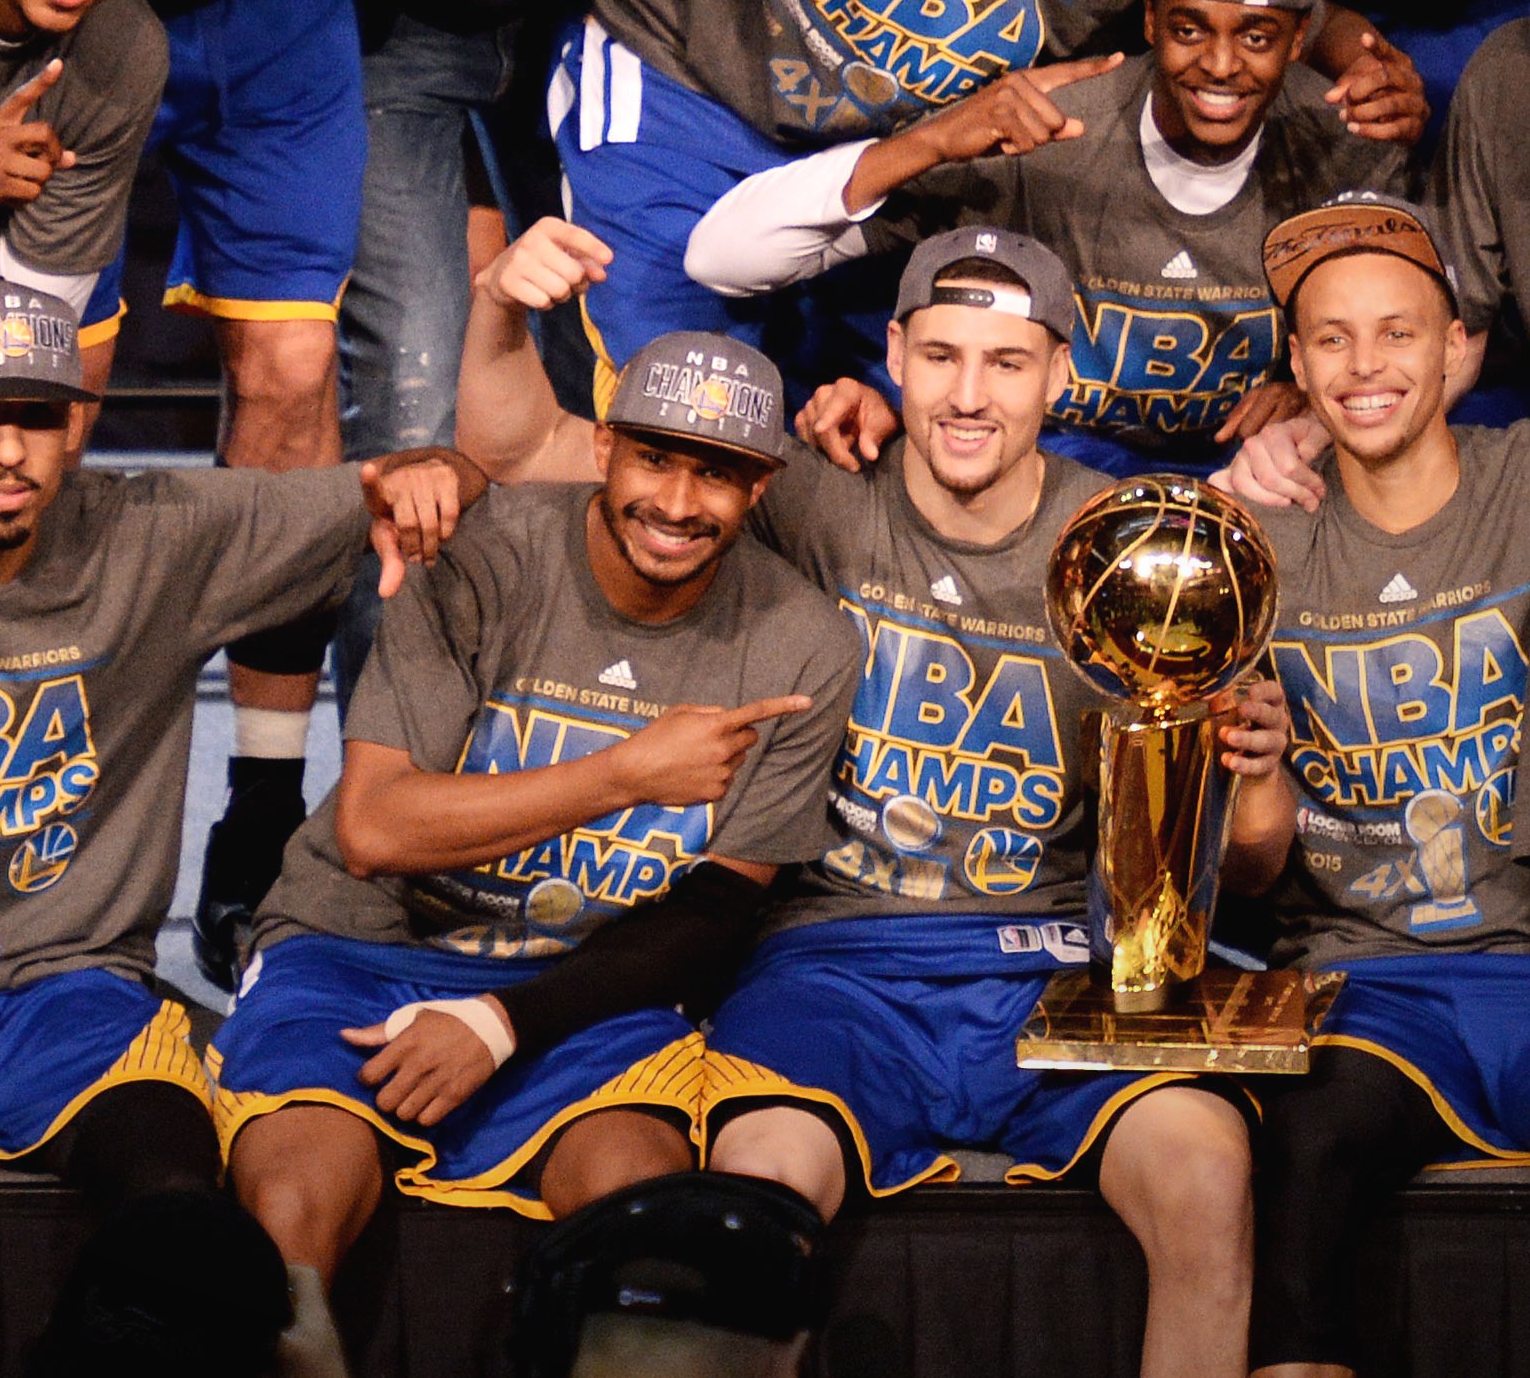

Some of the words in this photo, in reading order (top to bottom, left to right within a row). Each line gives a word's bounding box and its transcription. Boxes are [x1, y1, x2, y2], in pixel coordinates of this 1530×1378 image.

[1143, 284, 1193, 300] STATE
[1197, 285, 1268, 302] WARRIO
[686, 351, 750, 378] NBA
[1069, 291, 1278, 395] NBA
[1046, 383, 1247, 434] HAMP
[859, 583, 915, 612] GOEN
[961, 616, 1046, 643] WARRIORS
[1299, 611, 1363, 631] GLDEN
[1367, 609, 1415, 628] STATE
[1421, 580, 1492, 612] RRIORS
[515, 677, 577, 701] GLDEN
[579, 689, 630, 712] STATE
[839, 598, 1066, 773] NBA
[1269, 608, 1530, 752] NBA
[837, 732, 1065, 830] HAMPS
[1290, 717, 1522, 807] CHAMP
[473, 833, 692, 906] AMP
[823, 841, 896, 892] 4X
[1349, 849, 1429, 899] 4X
